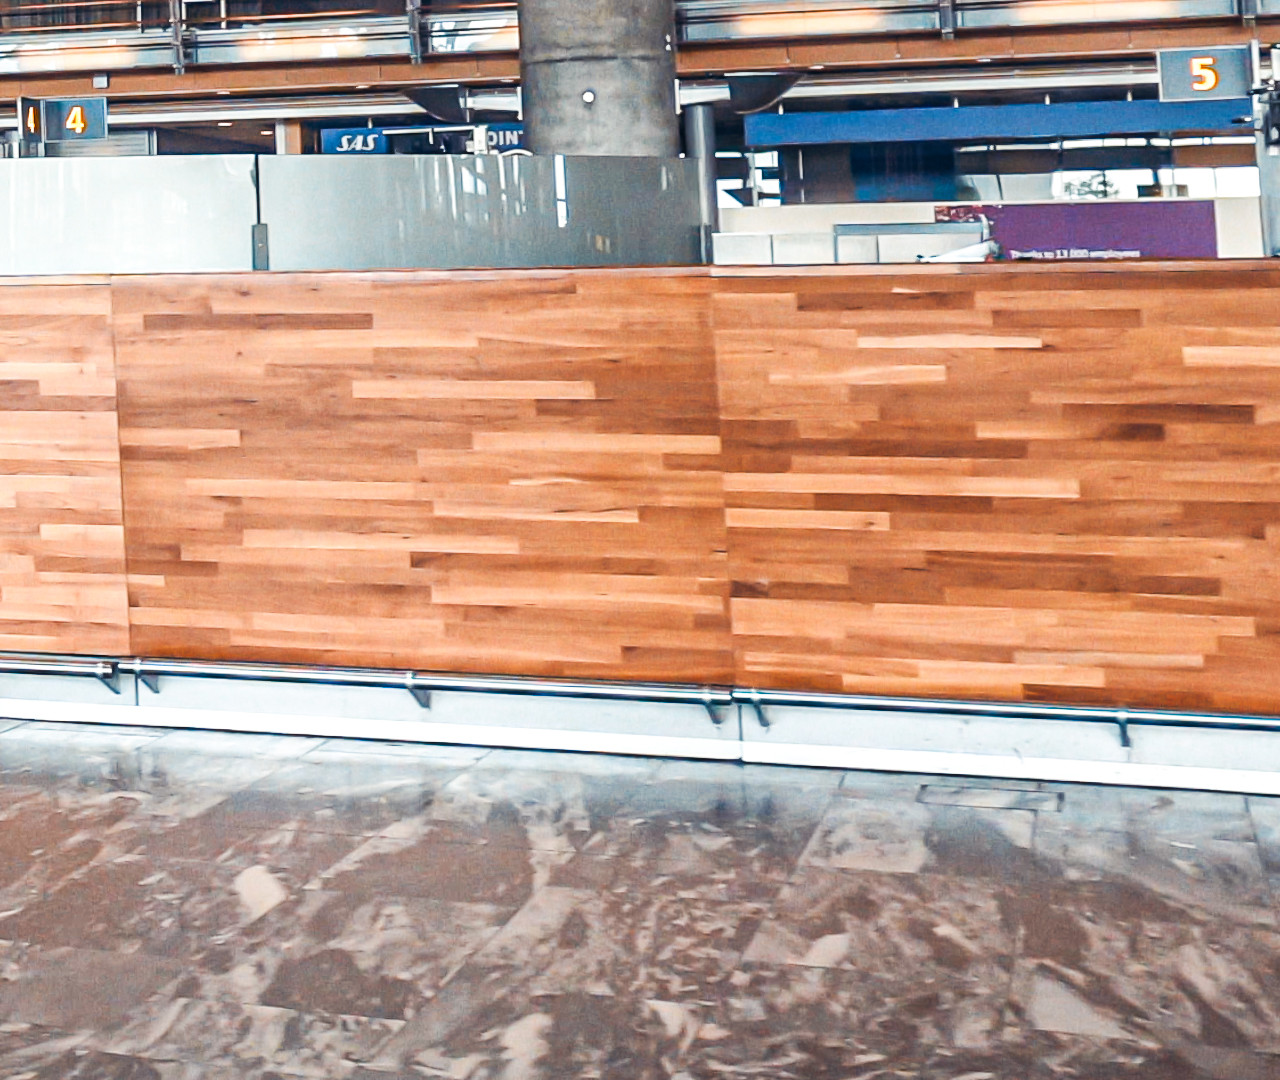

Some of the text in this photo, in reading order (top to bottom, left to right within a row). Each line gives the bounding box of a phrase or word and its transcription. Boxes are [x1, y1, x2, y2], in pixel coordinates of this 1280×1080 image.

[1190, 56, 1218, 90] 5
[65, 106, 86, 134] 4
[336, 134, 379, 151] SAS
